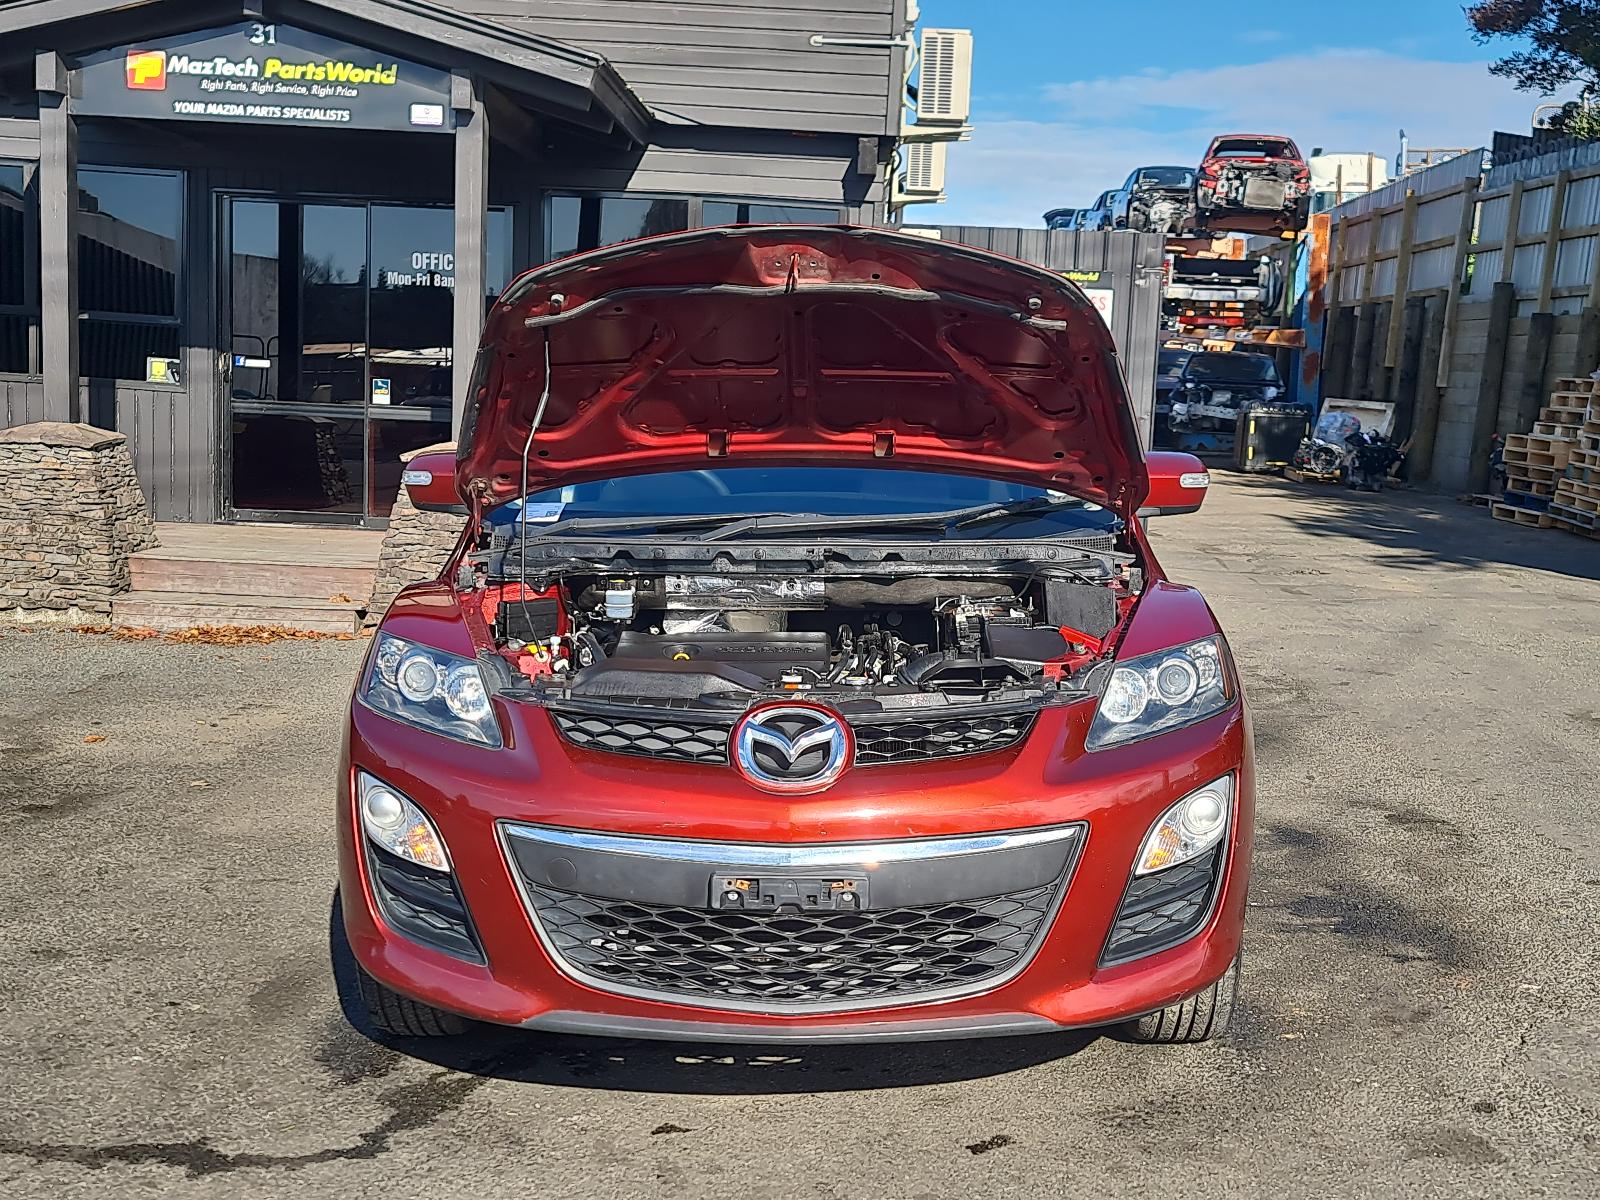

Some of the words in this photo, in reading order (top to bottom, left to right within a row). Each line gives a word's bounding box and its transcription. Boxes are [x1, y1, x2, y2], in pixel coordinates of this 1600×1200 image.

[250, 23, 275, 44] 31
[167, 55, 259, 77] MazTech
[264, 58, 397, 84] PartsWorld
[201, 79, 224, 92] Right
[225, 80, 248, 92] Parts,
[250, 81, 274, 95] Right
[275, 82, 309, 95] Service,
[311, 84, 334, 97] Right
[335, 85, 358, 97] Price
[173, 101, 205, 114] YOUR
[206, 103, 244, 116] MAZDA
[245, 105, 281, 118] PARTS
[281, 107, 350, 122] SPECIALISTS
[387, 271, 431, 286] Mon-Fri
